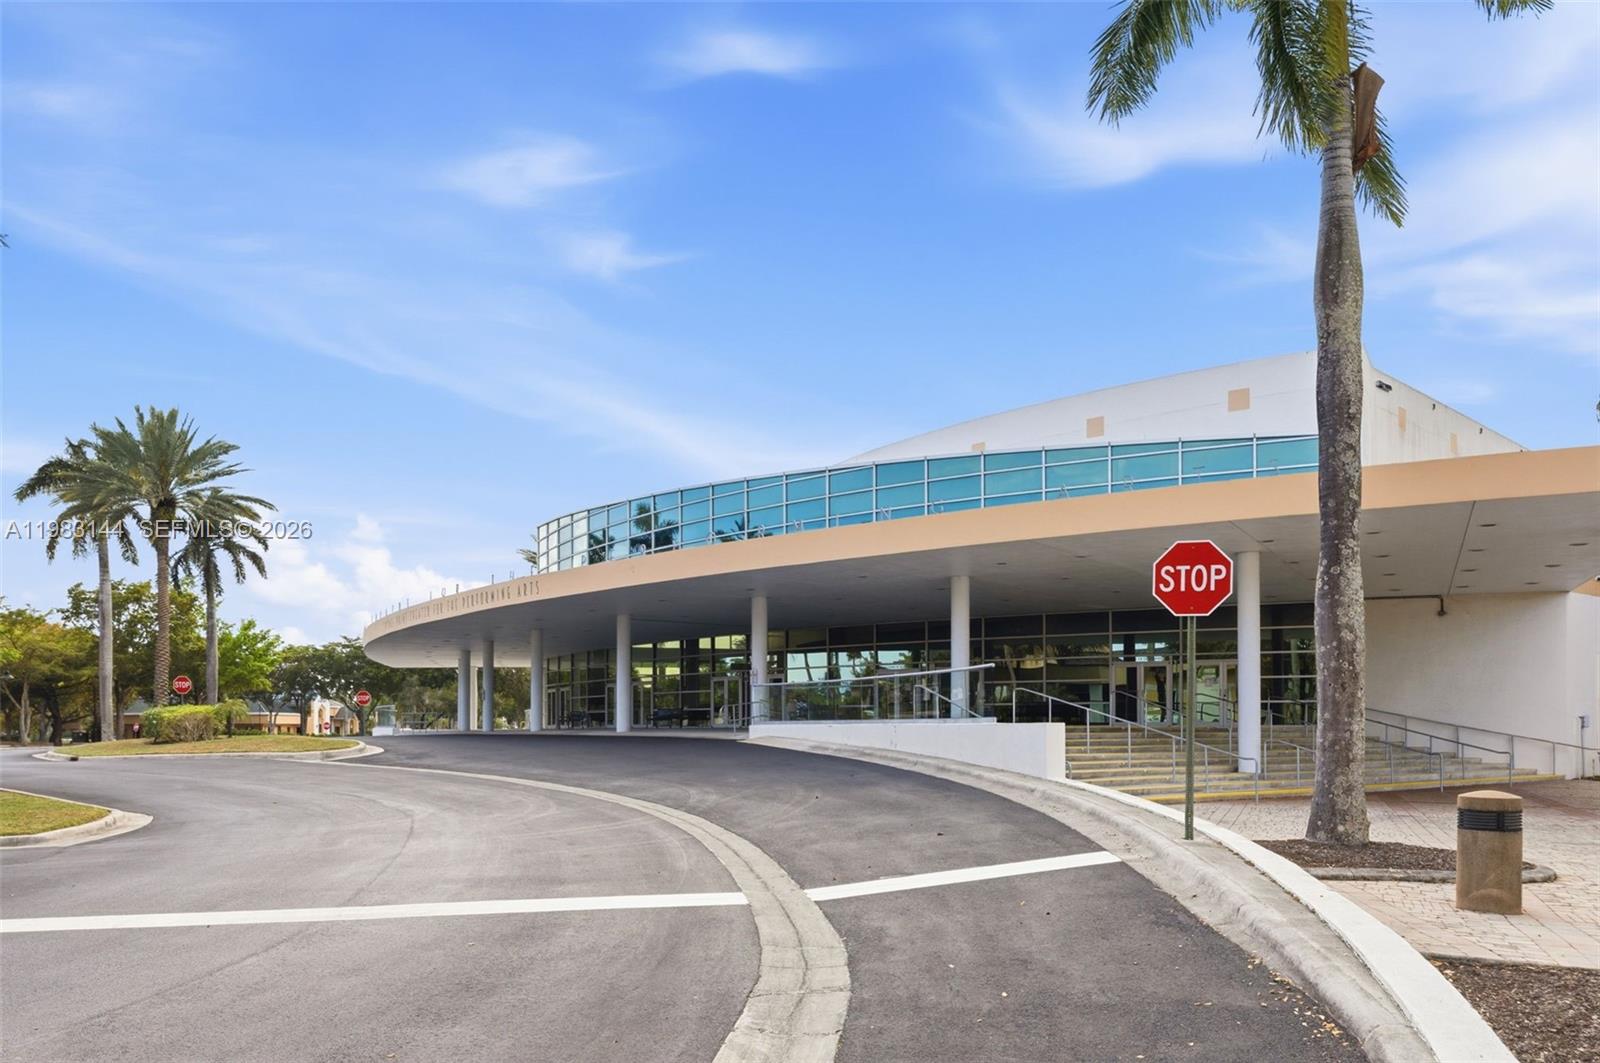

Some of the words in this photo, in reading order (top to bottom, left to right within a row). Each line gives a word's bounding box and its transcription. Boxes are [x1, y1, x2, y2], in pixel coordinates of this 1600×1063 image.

[1159, 564, 1227, 592] STOP
[462, 586, 511, 609] PERFORMING
[517, 580, 540, 597] ARTS
[174, 681, 190, 689] STOP
